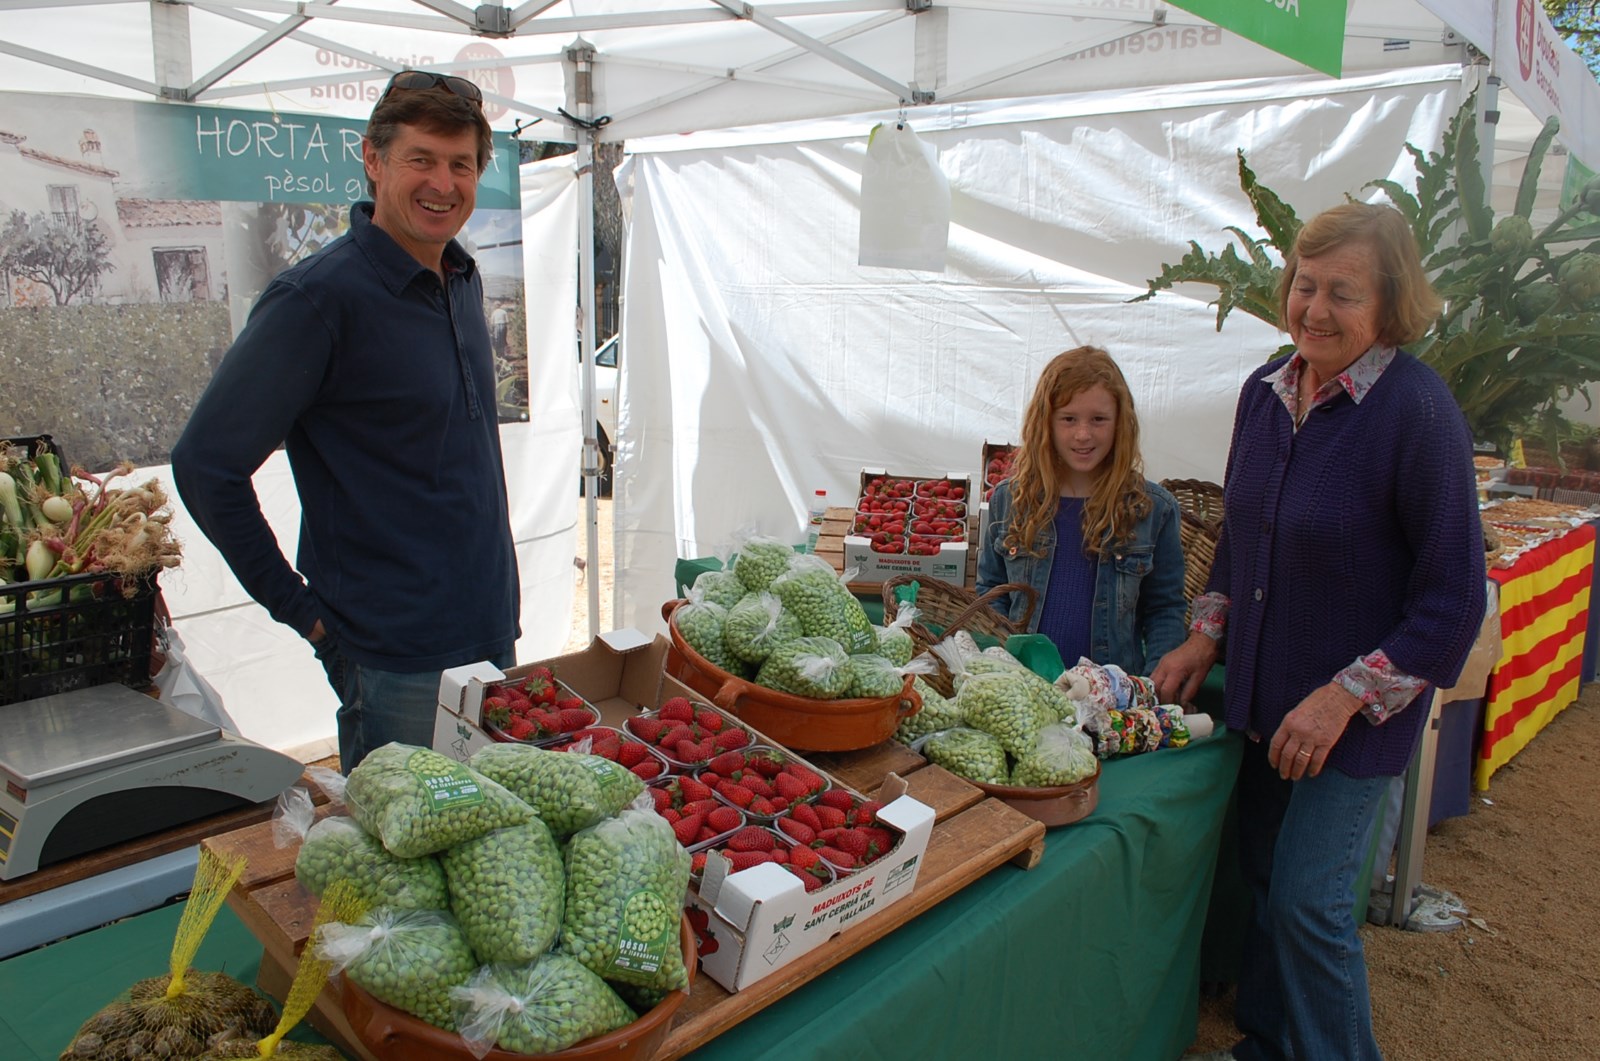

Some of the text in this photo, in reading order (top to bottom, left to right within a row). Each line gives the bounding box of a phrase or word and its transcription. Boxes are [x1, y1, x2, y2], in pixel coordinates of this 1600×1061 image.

[196, 115, 329, 163] HORTA
[264, 169, 335, 199] pèsol
[803, 912, 828, 932] SANT
[859, 888, 873, 902] DE
[811, 875, 876, 916] MADUIXOTS DE
[839, 896, 876, 924] VALLALTA
